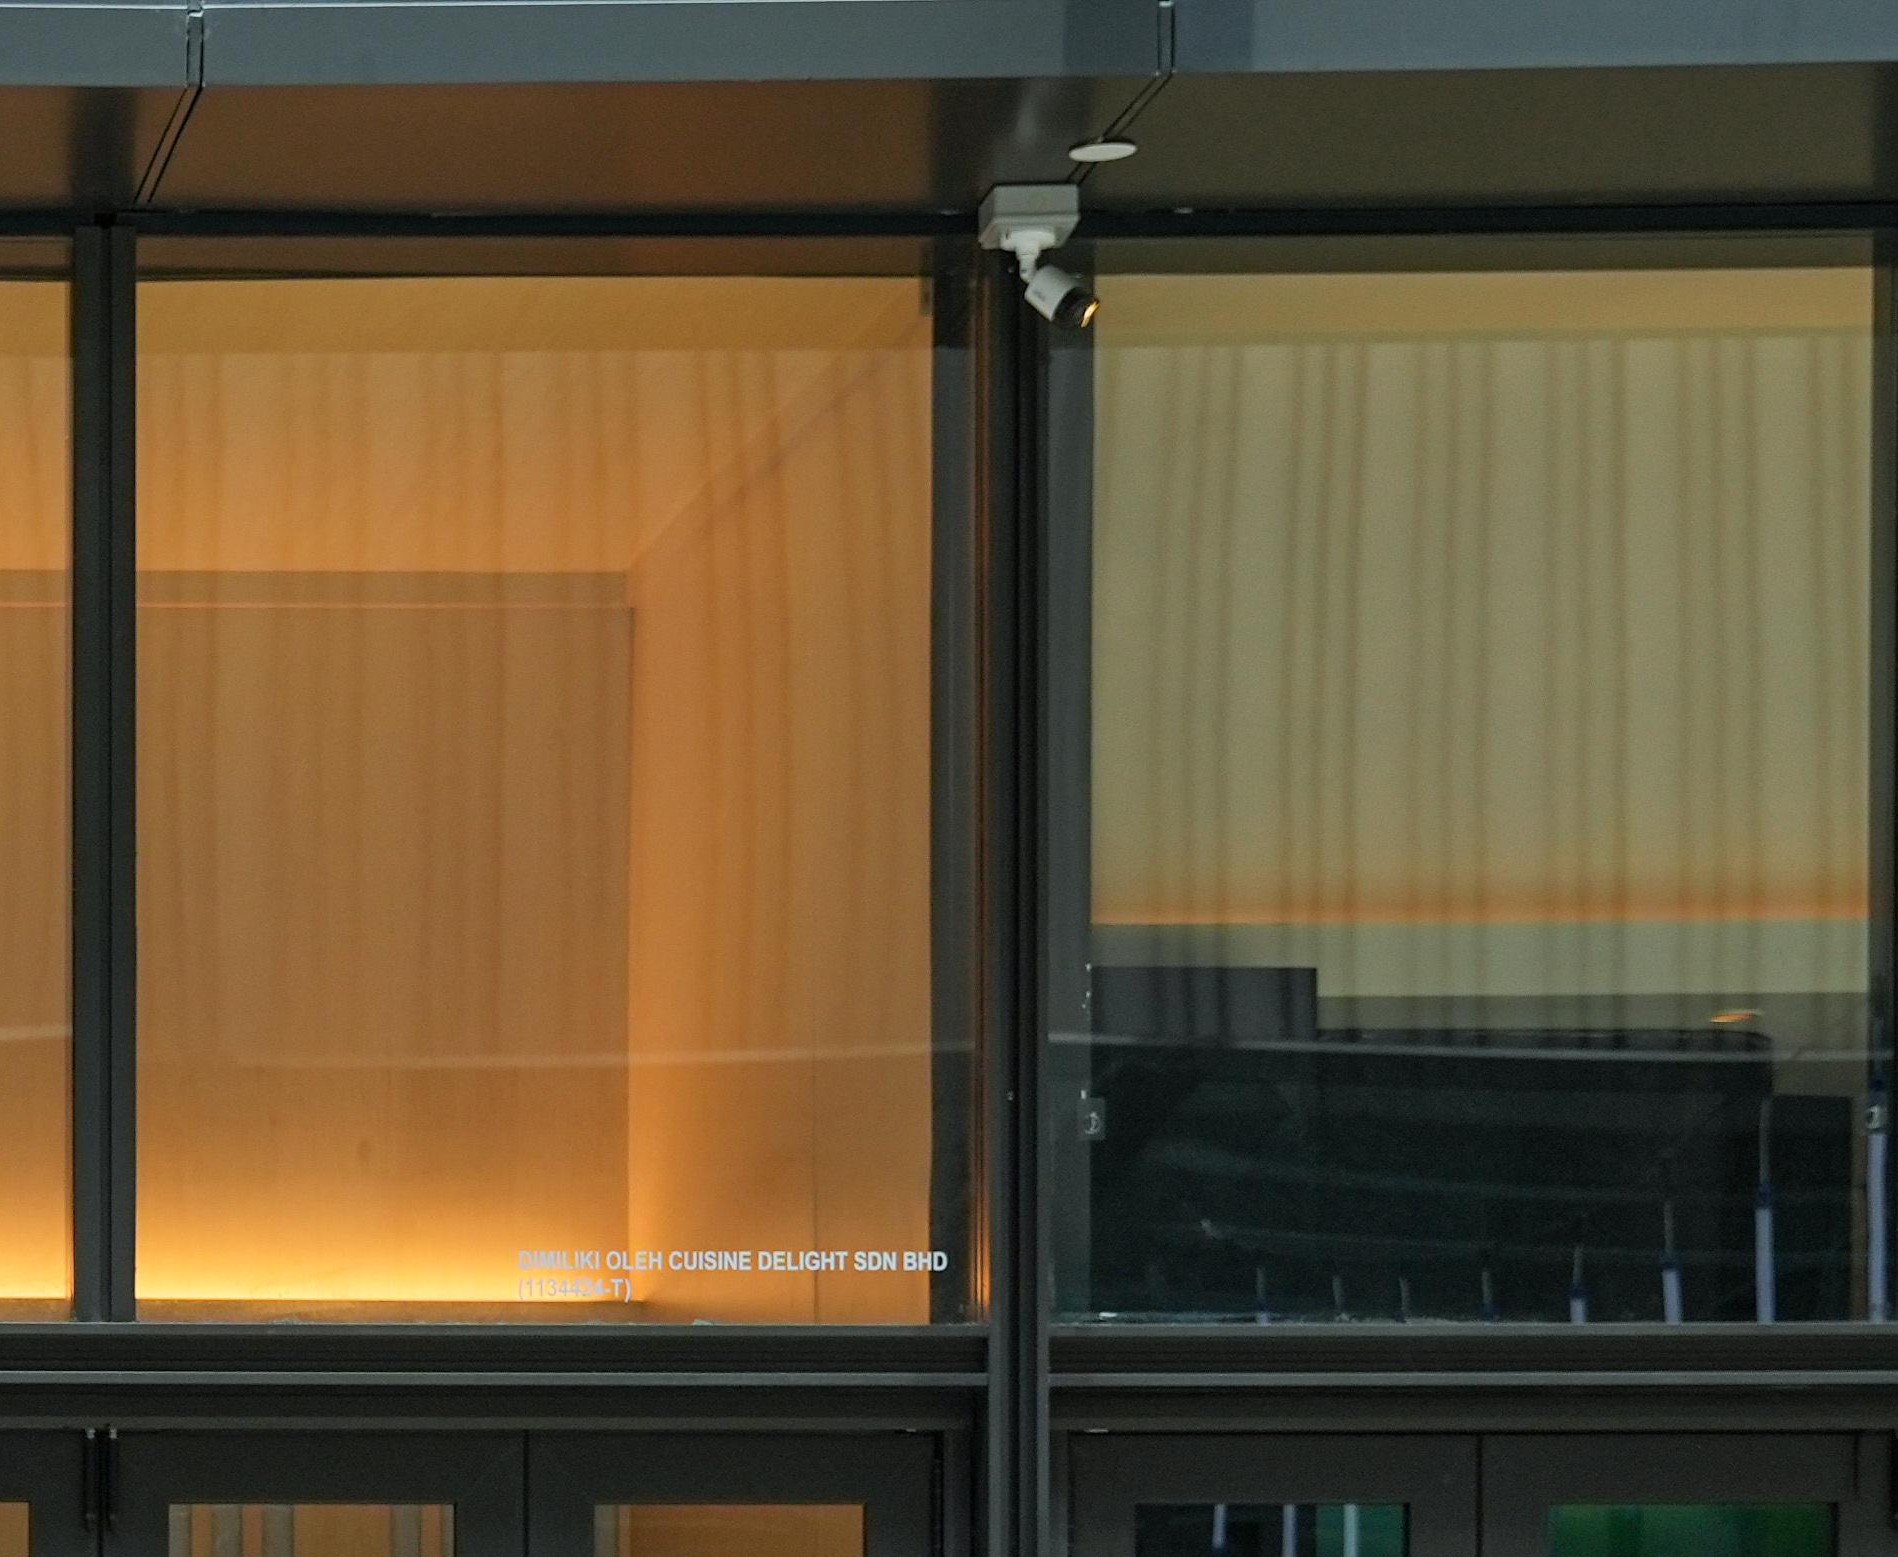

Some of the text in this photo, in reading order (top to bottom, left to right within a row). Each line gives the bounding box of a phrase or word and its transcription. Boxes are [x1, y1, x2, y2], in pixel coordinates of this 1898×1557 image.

[518, 1250, 948, 1272] DIMILIKI OLEH CUISINE DELIGHT SDN BHD
[518, 1279, 632, 1302] (1134424-T)
